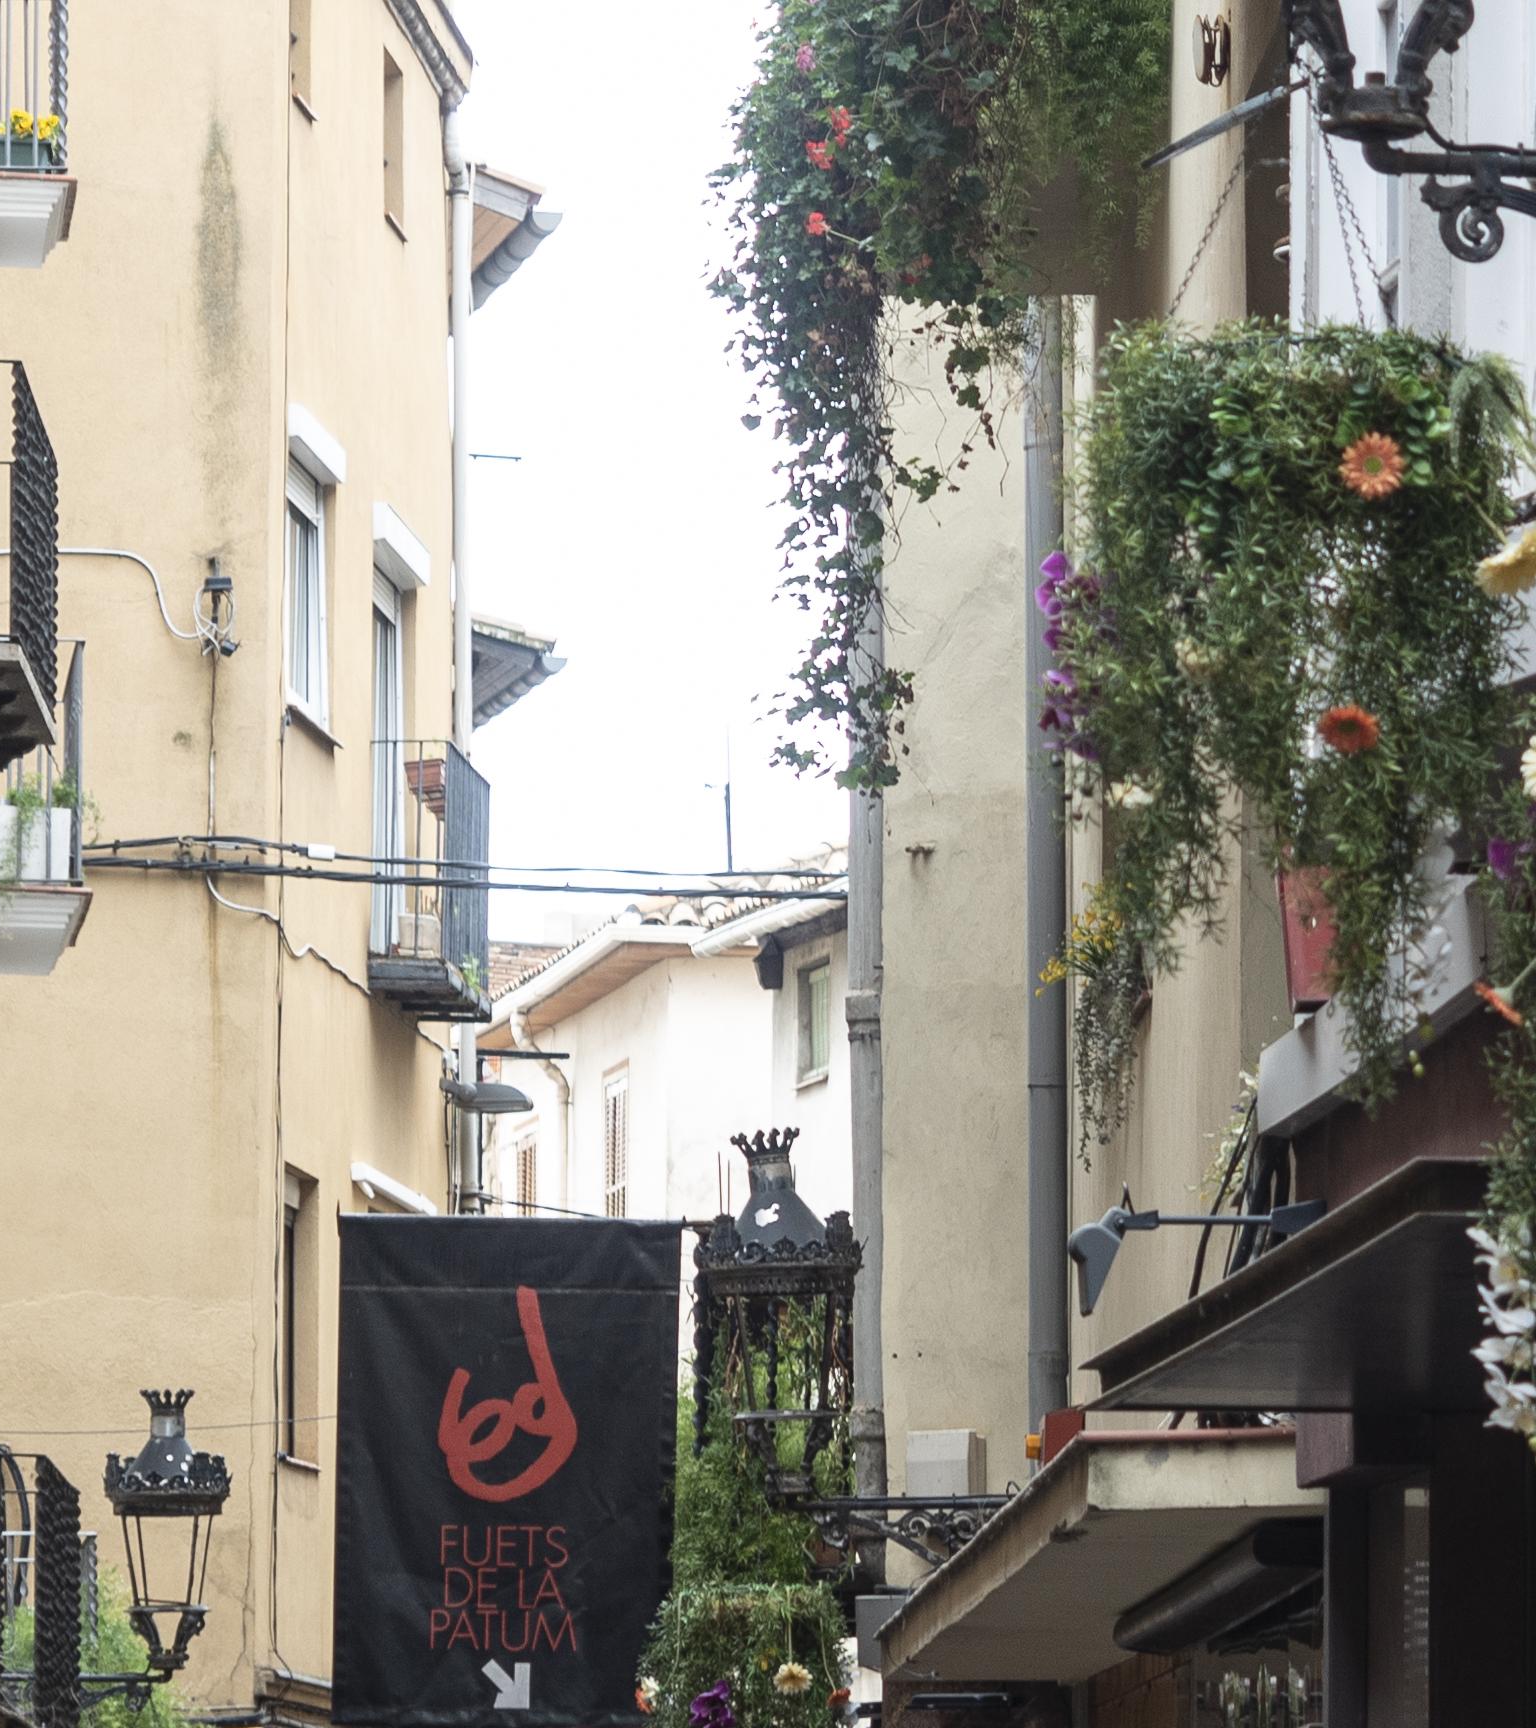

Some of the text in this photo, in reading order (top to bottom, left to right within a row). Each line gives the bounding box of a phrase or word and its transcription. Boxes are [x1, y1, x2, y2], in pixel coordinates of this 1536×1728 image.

[439, 1524, 569, 1569] FUETS
[444, 1567, 565, 1610] DE LA
[430, 1608, 577, 1652] PATUM
